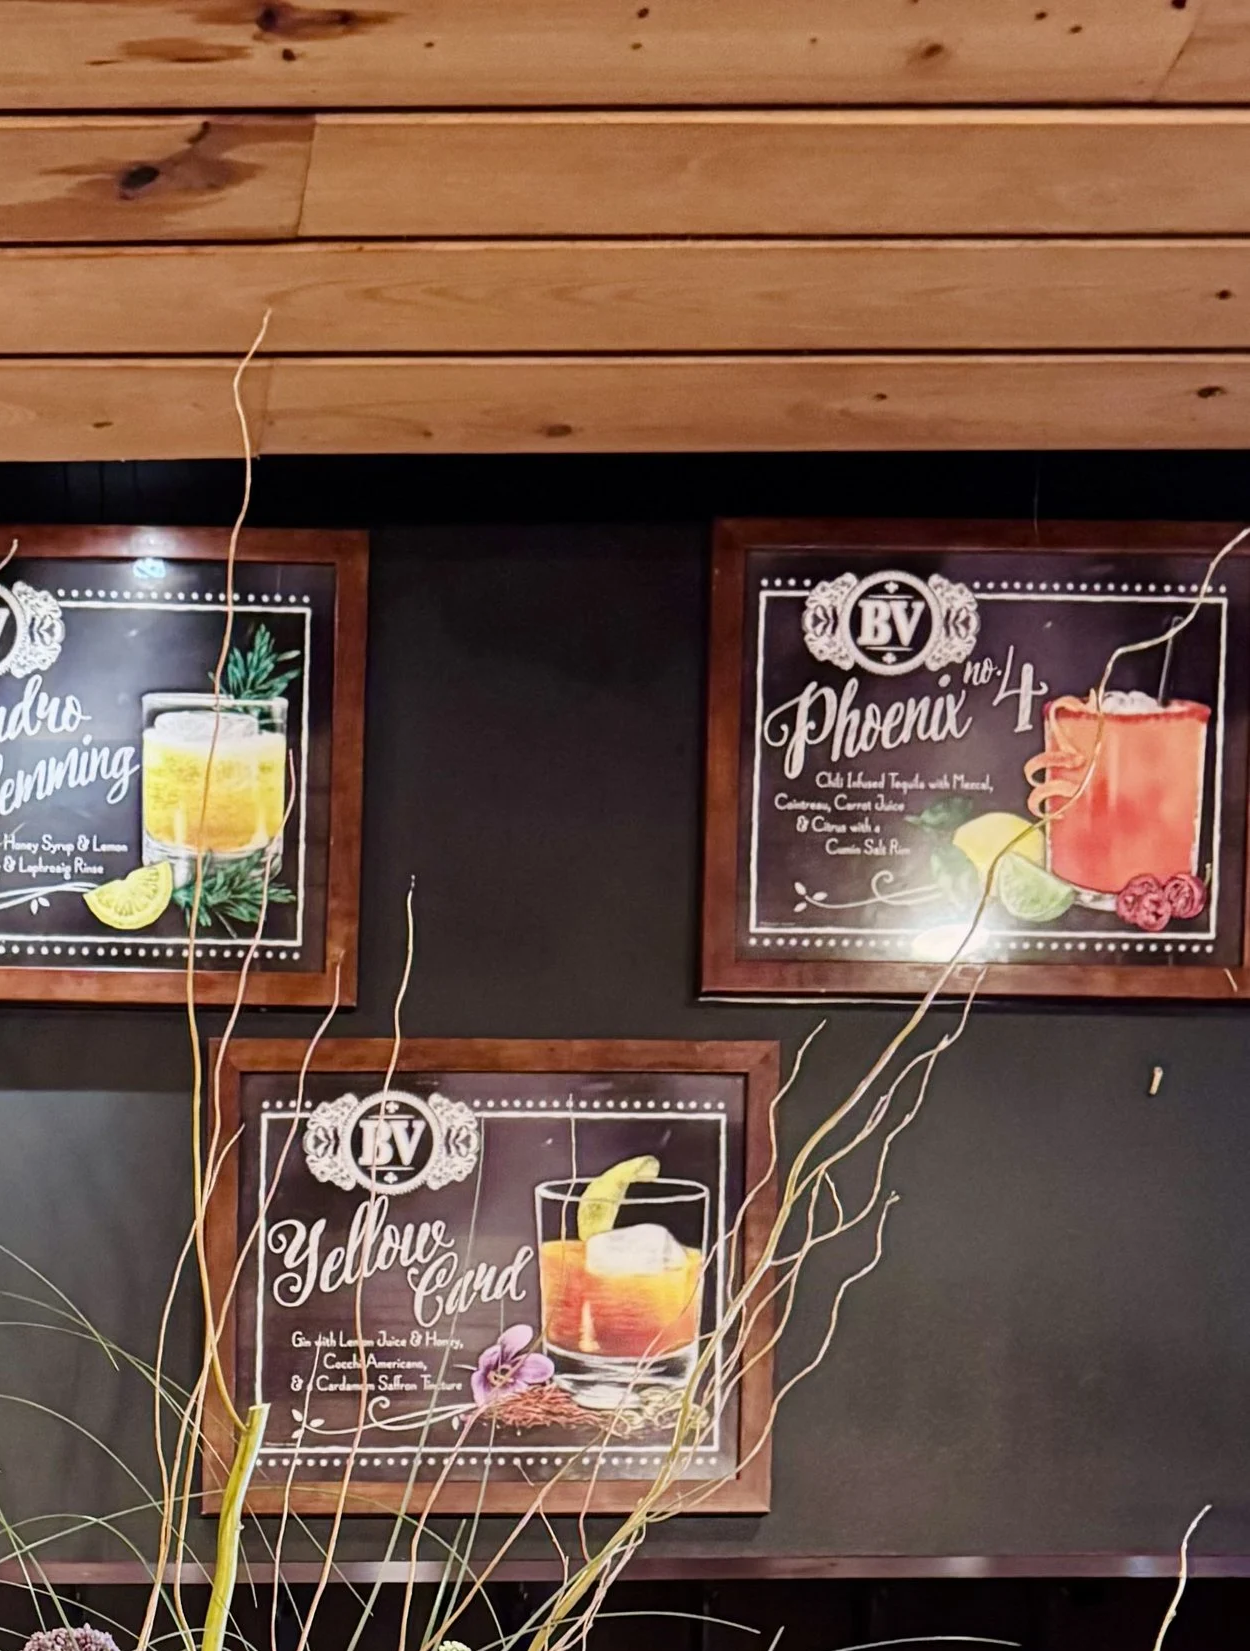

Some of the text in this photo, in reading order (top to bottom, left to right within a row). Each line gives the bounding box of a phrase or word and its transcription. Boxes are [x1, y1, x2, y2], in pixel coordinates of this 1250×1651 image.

[857, 599, 924, 647] BV
[764, 674, 972, 779] Phoenix
[992, 645, 1048, 733] 4
[815, 771, 994, 795] Chili Infused Tequila with Mezcal,
[774, 793, 905, 813] Cointreau, Carrot Juice
[796, 816, 881, 834] & Citrus with a
[3, 833, 39, 854] Honey
[41, 834, 73, 857] Syrup
[77, 835, 90, 852] &
[92, 834, 128, 853] Lemon
[825, 838, 862, 855] Cumin
[864, 839, 886, 856] Salt
[3, 857, 16, 872] &
[19, 857, 72, 879] Laphroaig
[74, 858, 104, 874] Rinse
[358, 1119, 426, 1167] BV
[267, 1195, 455, 1308] Yellow
[407, 1245, 534, 1328] Card
[291, 1331, 311, 1348] Gin
[314, 1331, 337, 1348] with
[376, 1330, 407, 1347] Juice
[410, 1330, 423, 1347] &
[323, 1352, 428, 1371] Cocch Americano,
[290, 1375, 303, 1391] &
[316, 1374, 375, 1391] Cardamm
[378, 1374, 417, 1391] Saffron
[420, 1374, 462, 1391] Tinture
